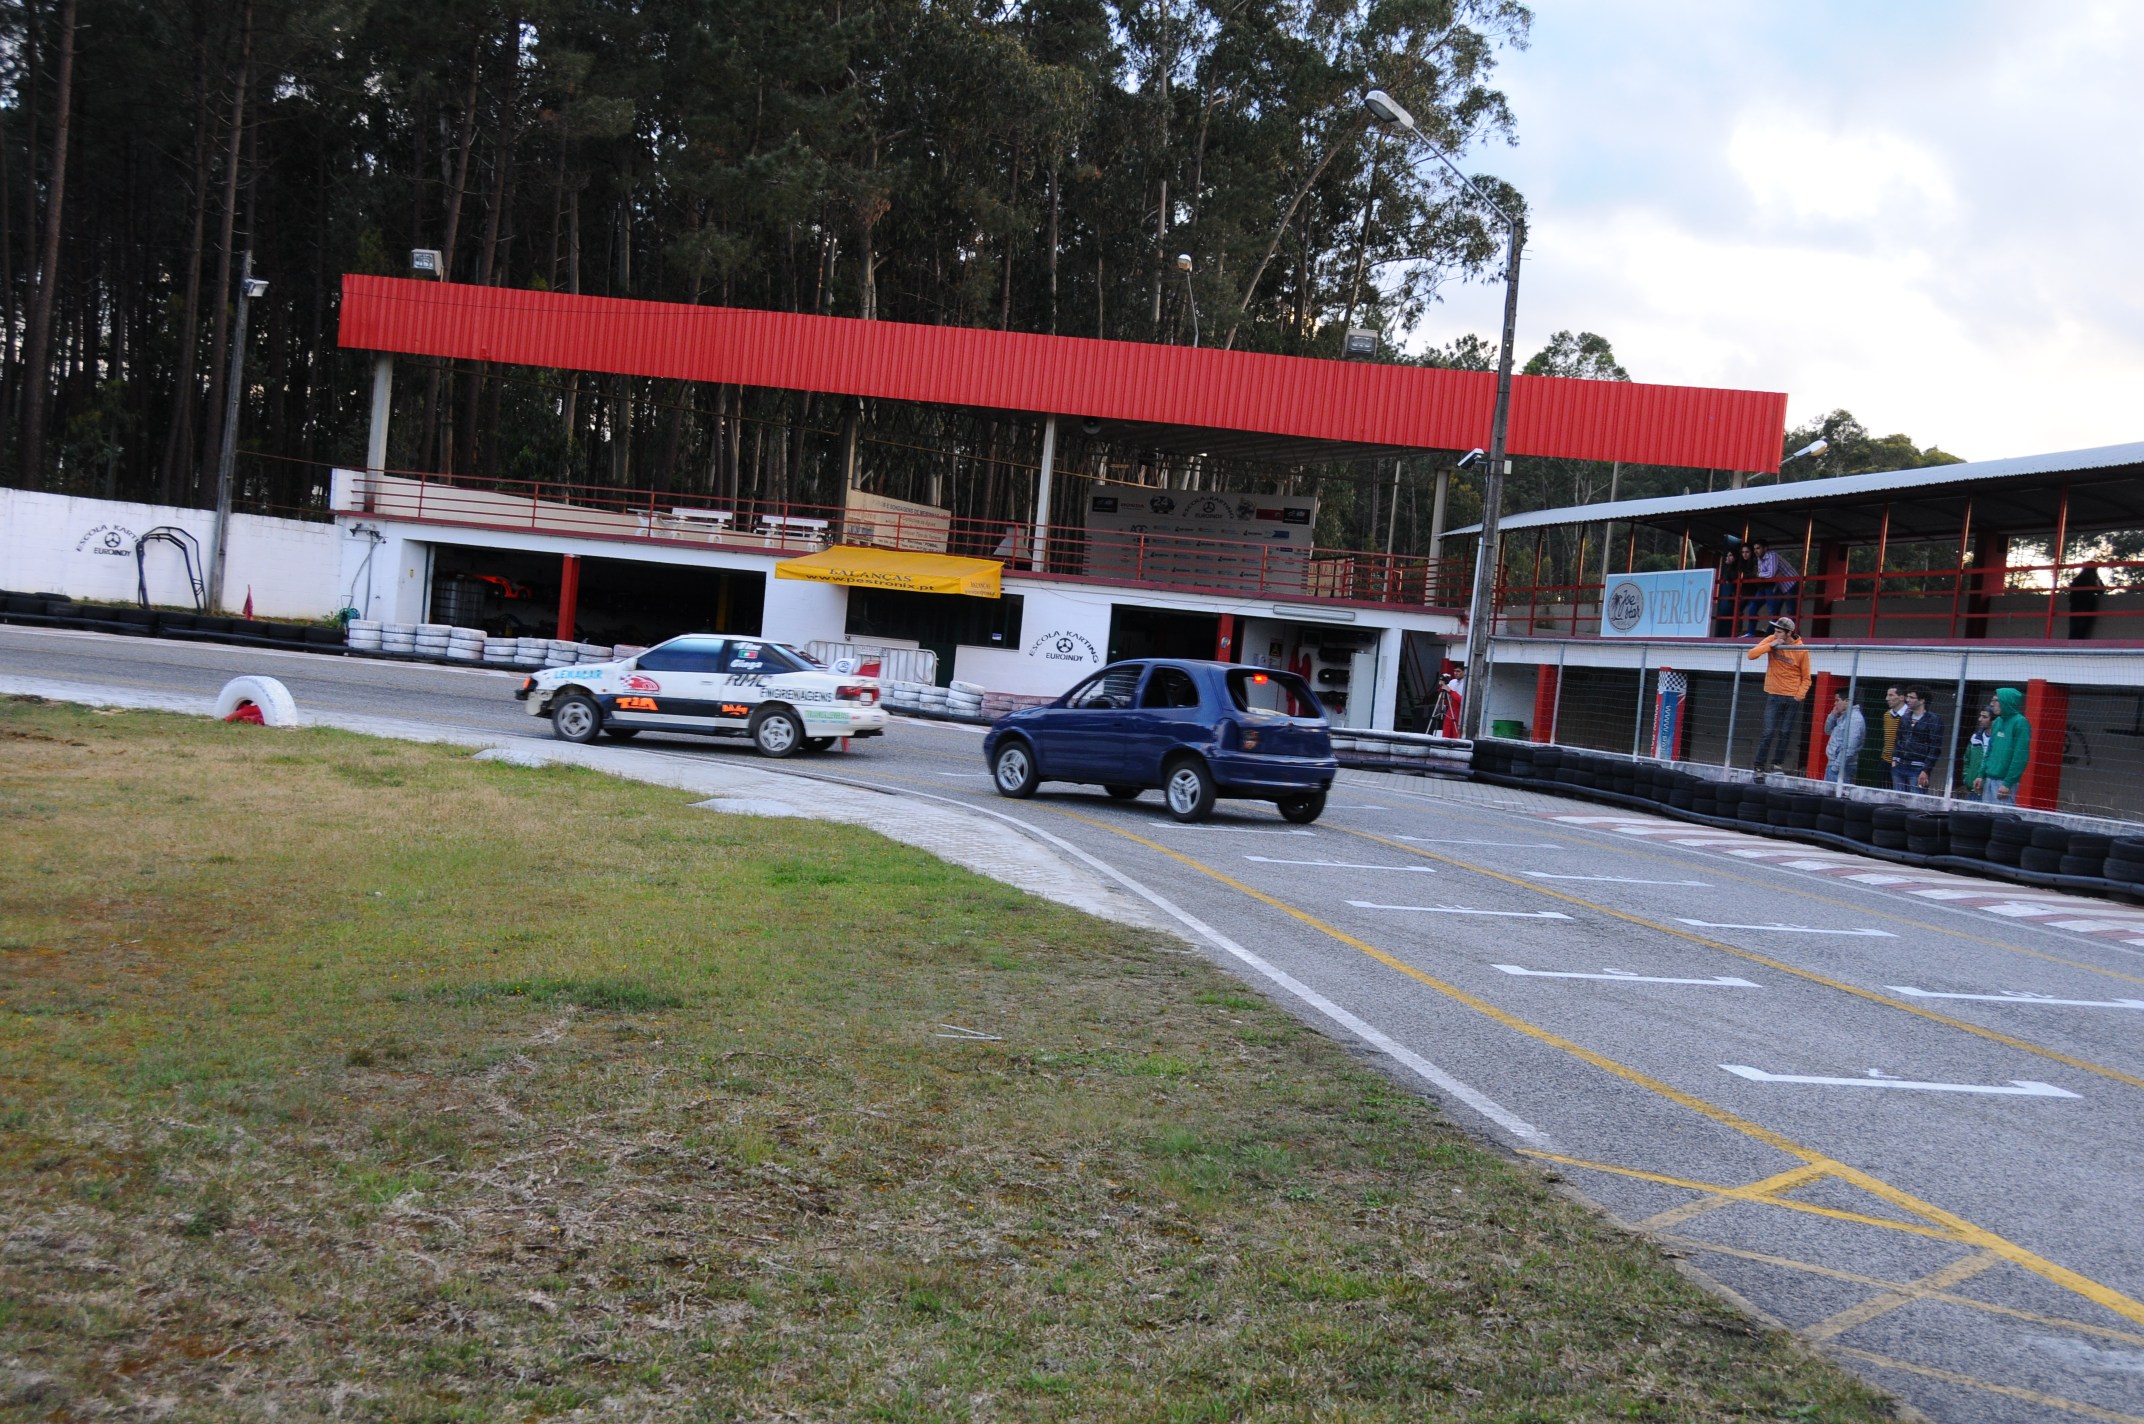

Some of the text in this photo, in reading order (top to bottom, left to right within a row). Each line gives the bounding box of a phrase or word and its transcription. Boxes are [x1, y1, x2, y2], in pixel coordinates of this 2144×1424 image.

[77, 524, 108, 552] ESCOLA
[94, 547, 132, 557] EUROINDY
[1648, 581, 1709, 625] VERÃO
[1029, 630, 1099, 664] ESCOLA KARTING
[1046, 652, 1083, 662] EUROINDY
[724, 673, 773, 688] RMC
[760, 687, 833, 703] ENGRENAGENS
